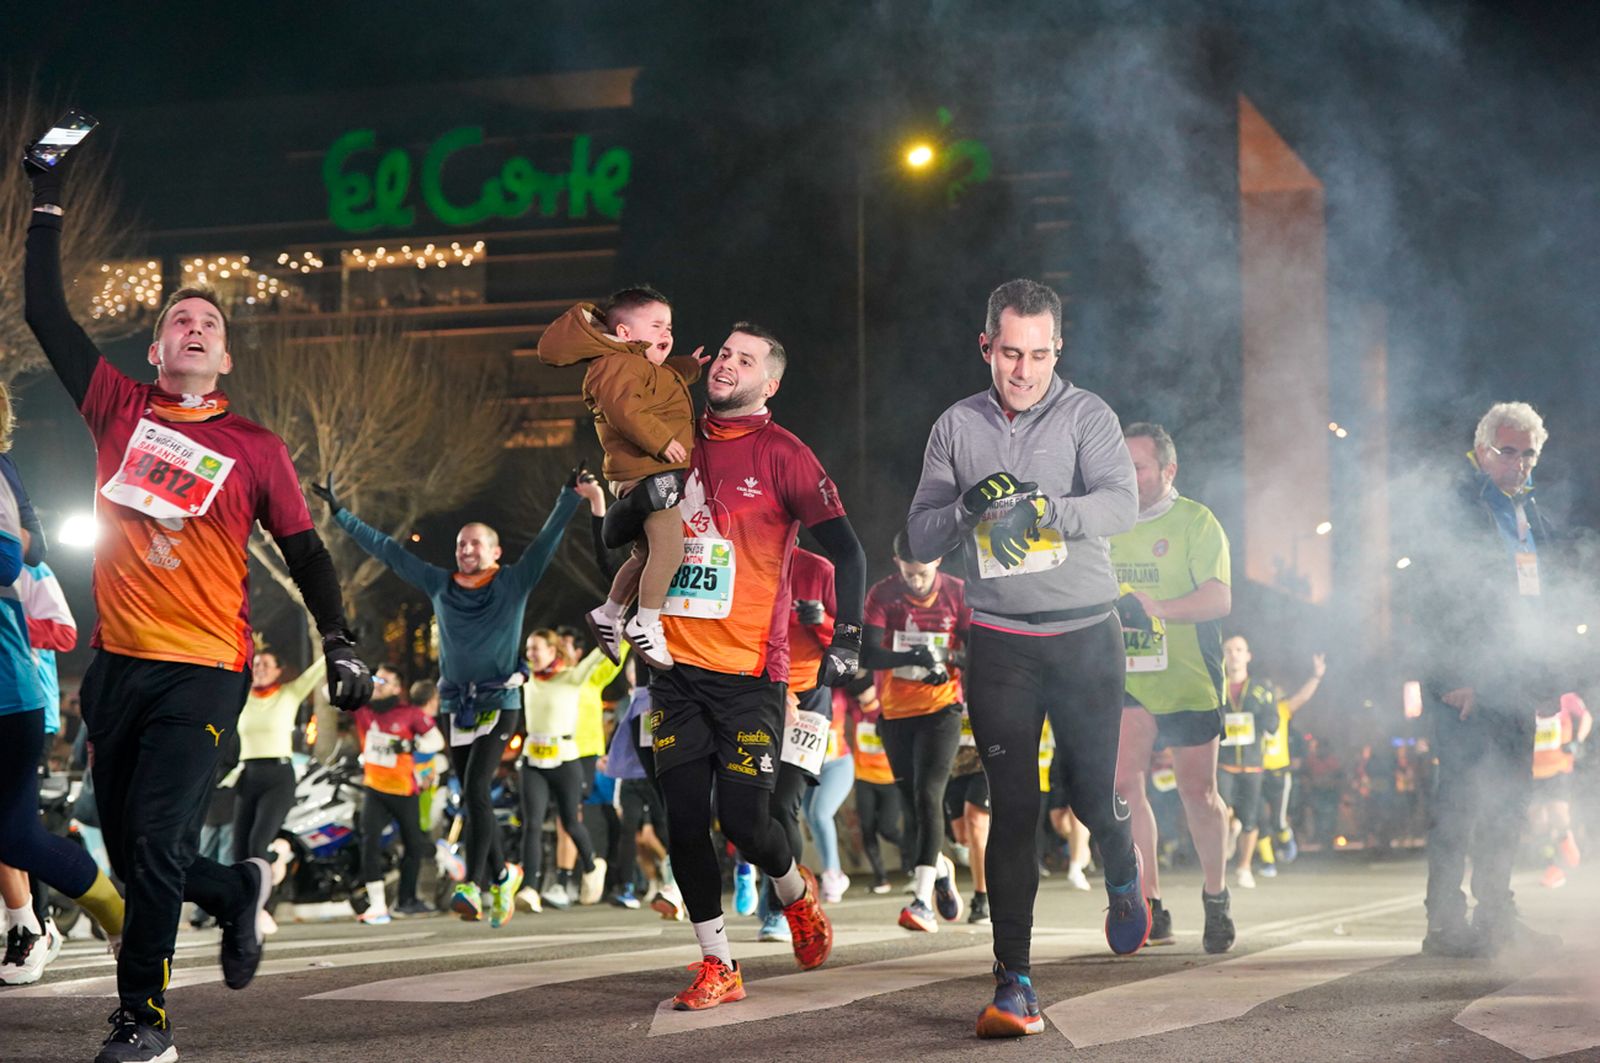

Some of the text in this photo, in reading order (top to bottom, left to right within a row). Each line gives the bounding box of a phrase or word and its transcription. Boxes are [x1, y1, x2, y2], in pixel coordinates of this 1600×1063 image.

[322, 126, 634, 233] El Corte
[138, 441, 158, 453] SAN
[154, 436, 195, 459] NOCHE DE
[134, 453, 197, 499] 9812
[689, 511, 711, 533] 43
[790, 727, 822, 752] 3721
